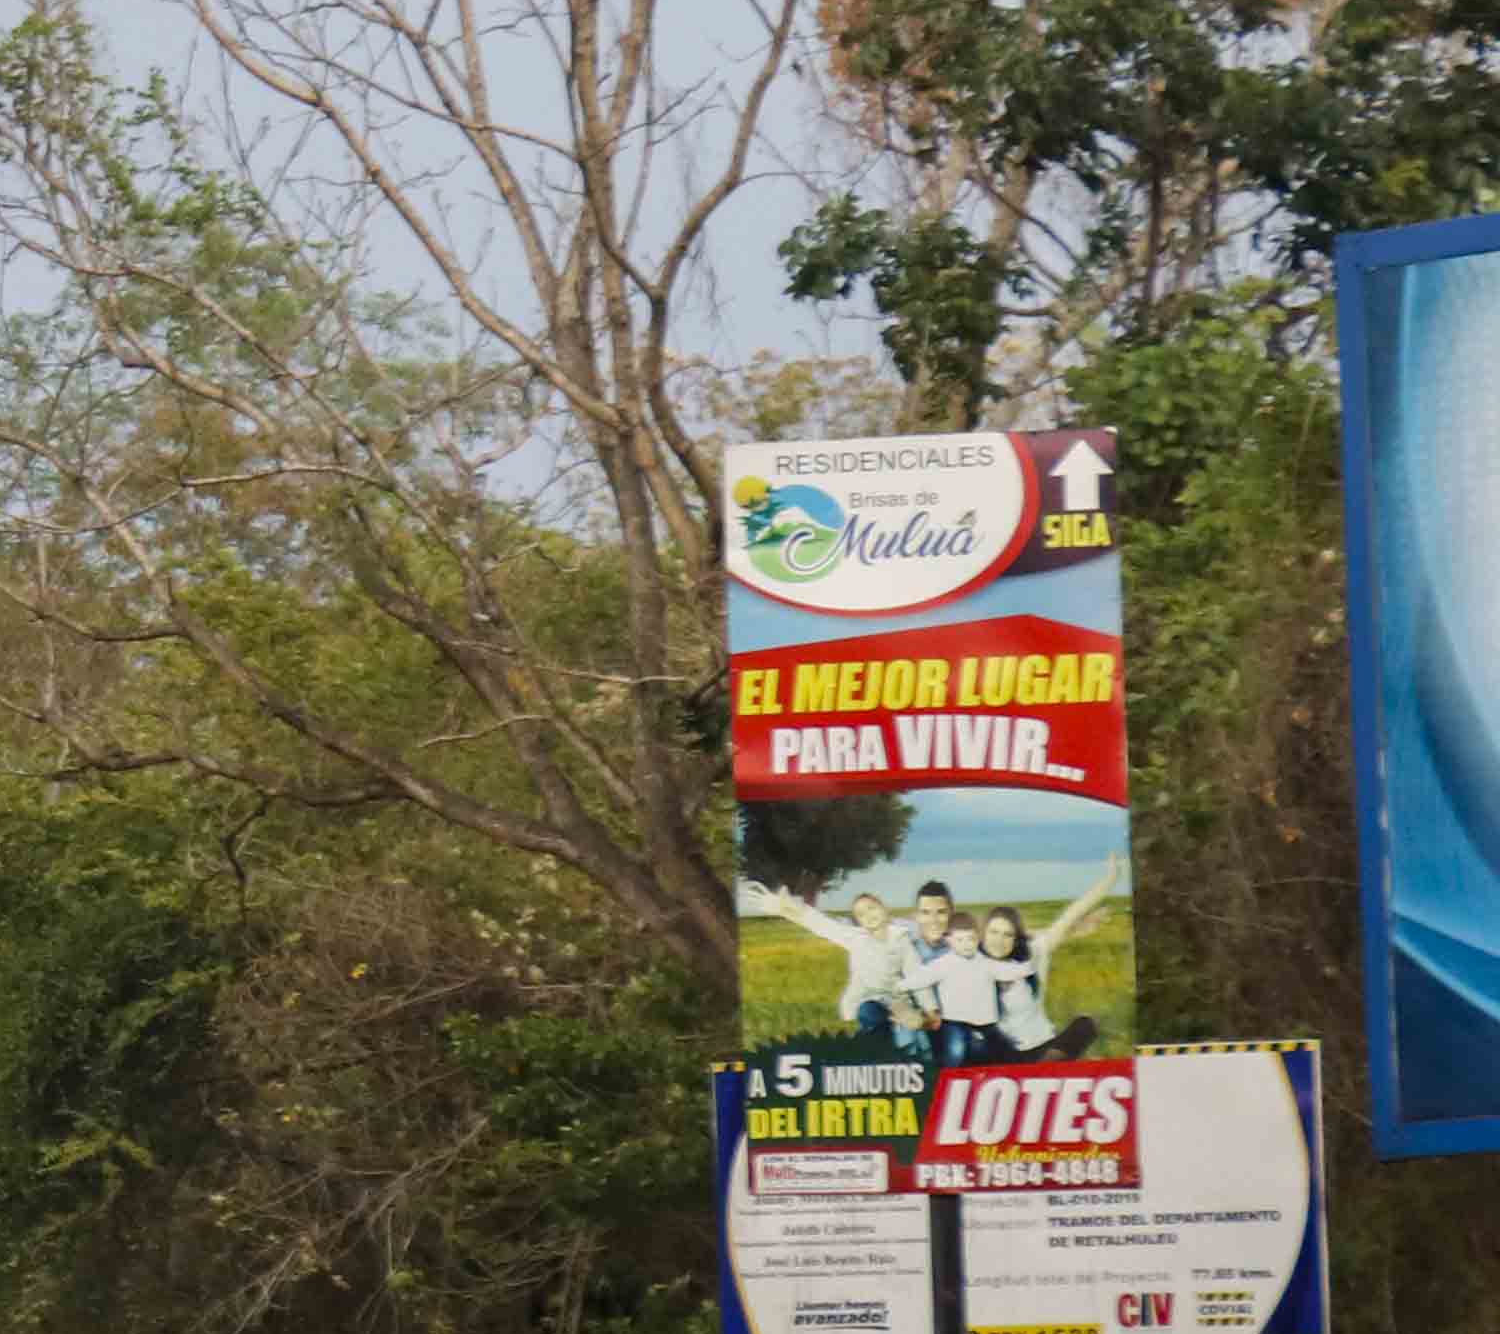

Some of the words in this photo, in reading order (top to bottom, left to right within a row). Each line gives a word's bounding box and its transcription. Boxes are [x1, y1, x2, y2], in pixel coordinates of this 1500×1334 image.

[775, 445, 996, 476] RESIDENCIALES
[850, 492, 908, 508] Brisas
[916, 490, 940, 506] de
[1043, 514, 1112, 549] SIGA
[737, 668, 782, 715] EL
[792, 659, 949, 713] MEJOR
[956, 652, 1115, 707] LUGAR
[771, 724, 888, 774] PARA
[750, 1069, 767, 1098] A
[776, 1054, 813, 1097] 5
[821, 1063, 924, 1096] MINUTOS
[748, 1108, 801, 1139] DEL
[806, 1098, 919, 1137] IRTRA
[936, 1076, 1132, 1145] LOTES
[1118, 1214, 1149, 1228] DEL
[1117, 1292, 1174, 1327] CIV
